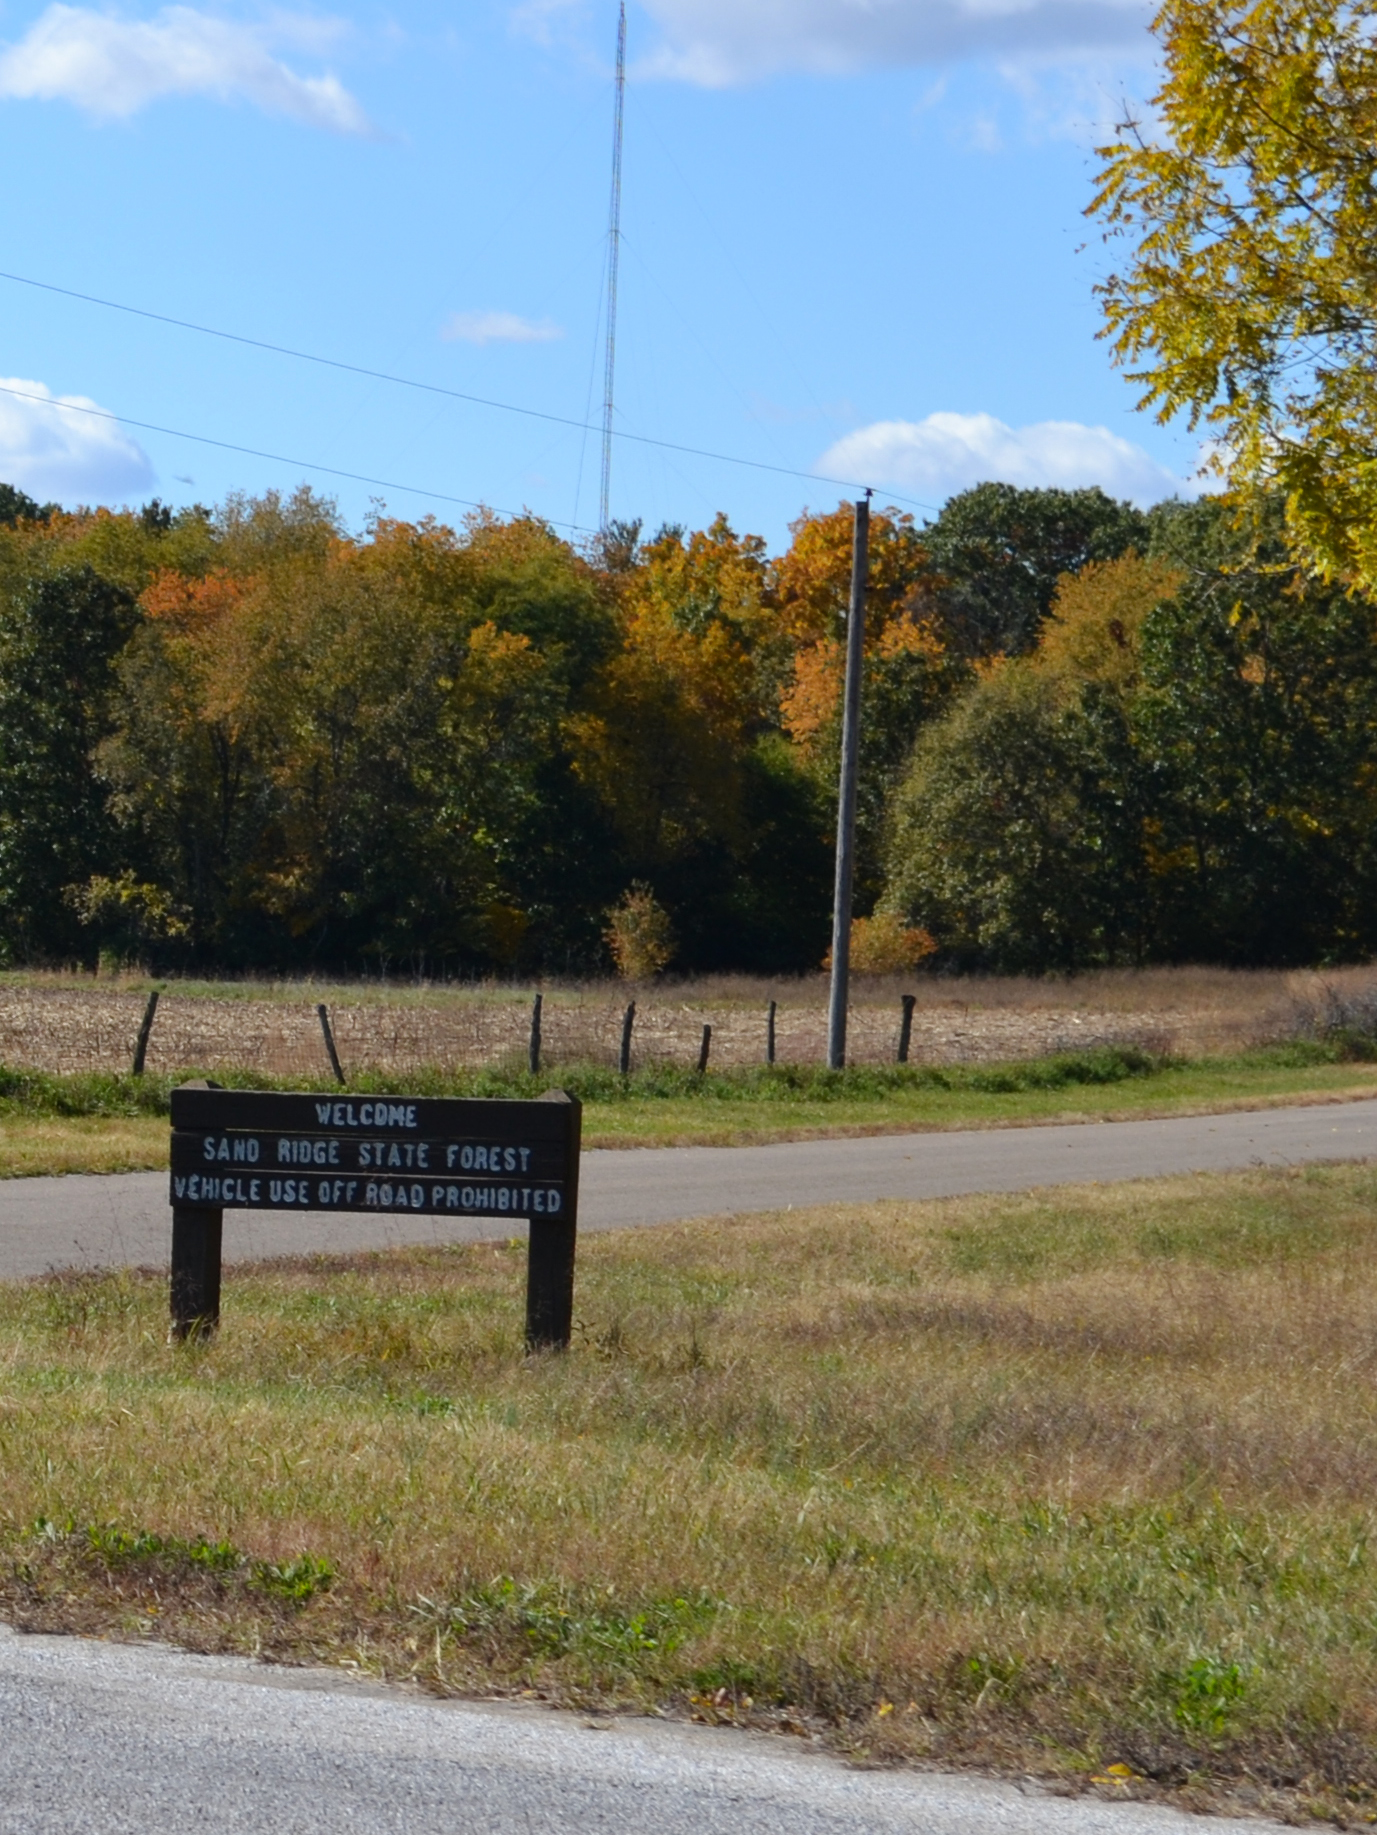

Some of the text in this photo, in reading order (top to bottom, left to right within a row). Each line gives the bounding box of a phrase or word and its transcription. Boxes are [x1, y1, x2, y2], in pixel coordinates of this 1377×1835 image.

[315, 1102, 418, 1128] WELCOME
[203, 1136, 531, 1172] SAND RIDGE STATE FOREST
[174, 1174, 562, 1213] VEHICLE USE OFF ROAD PROHIBITED
